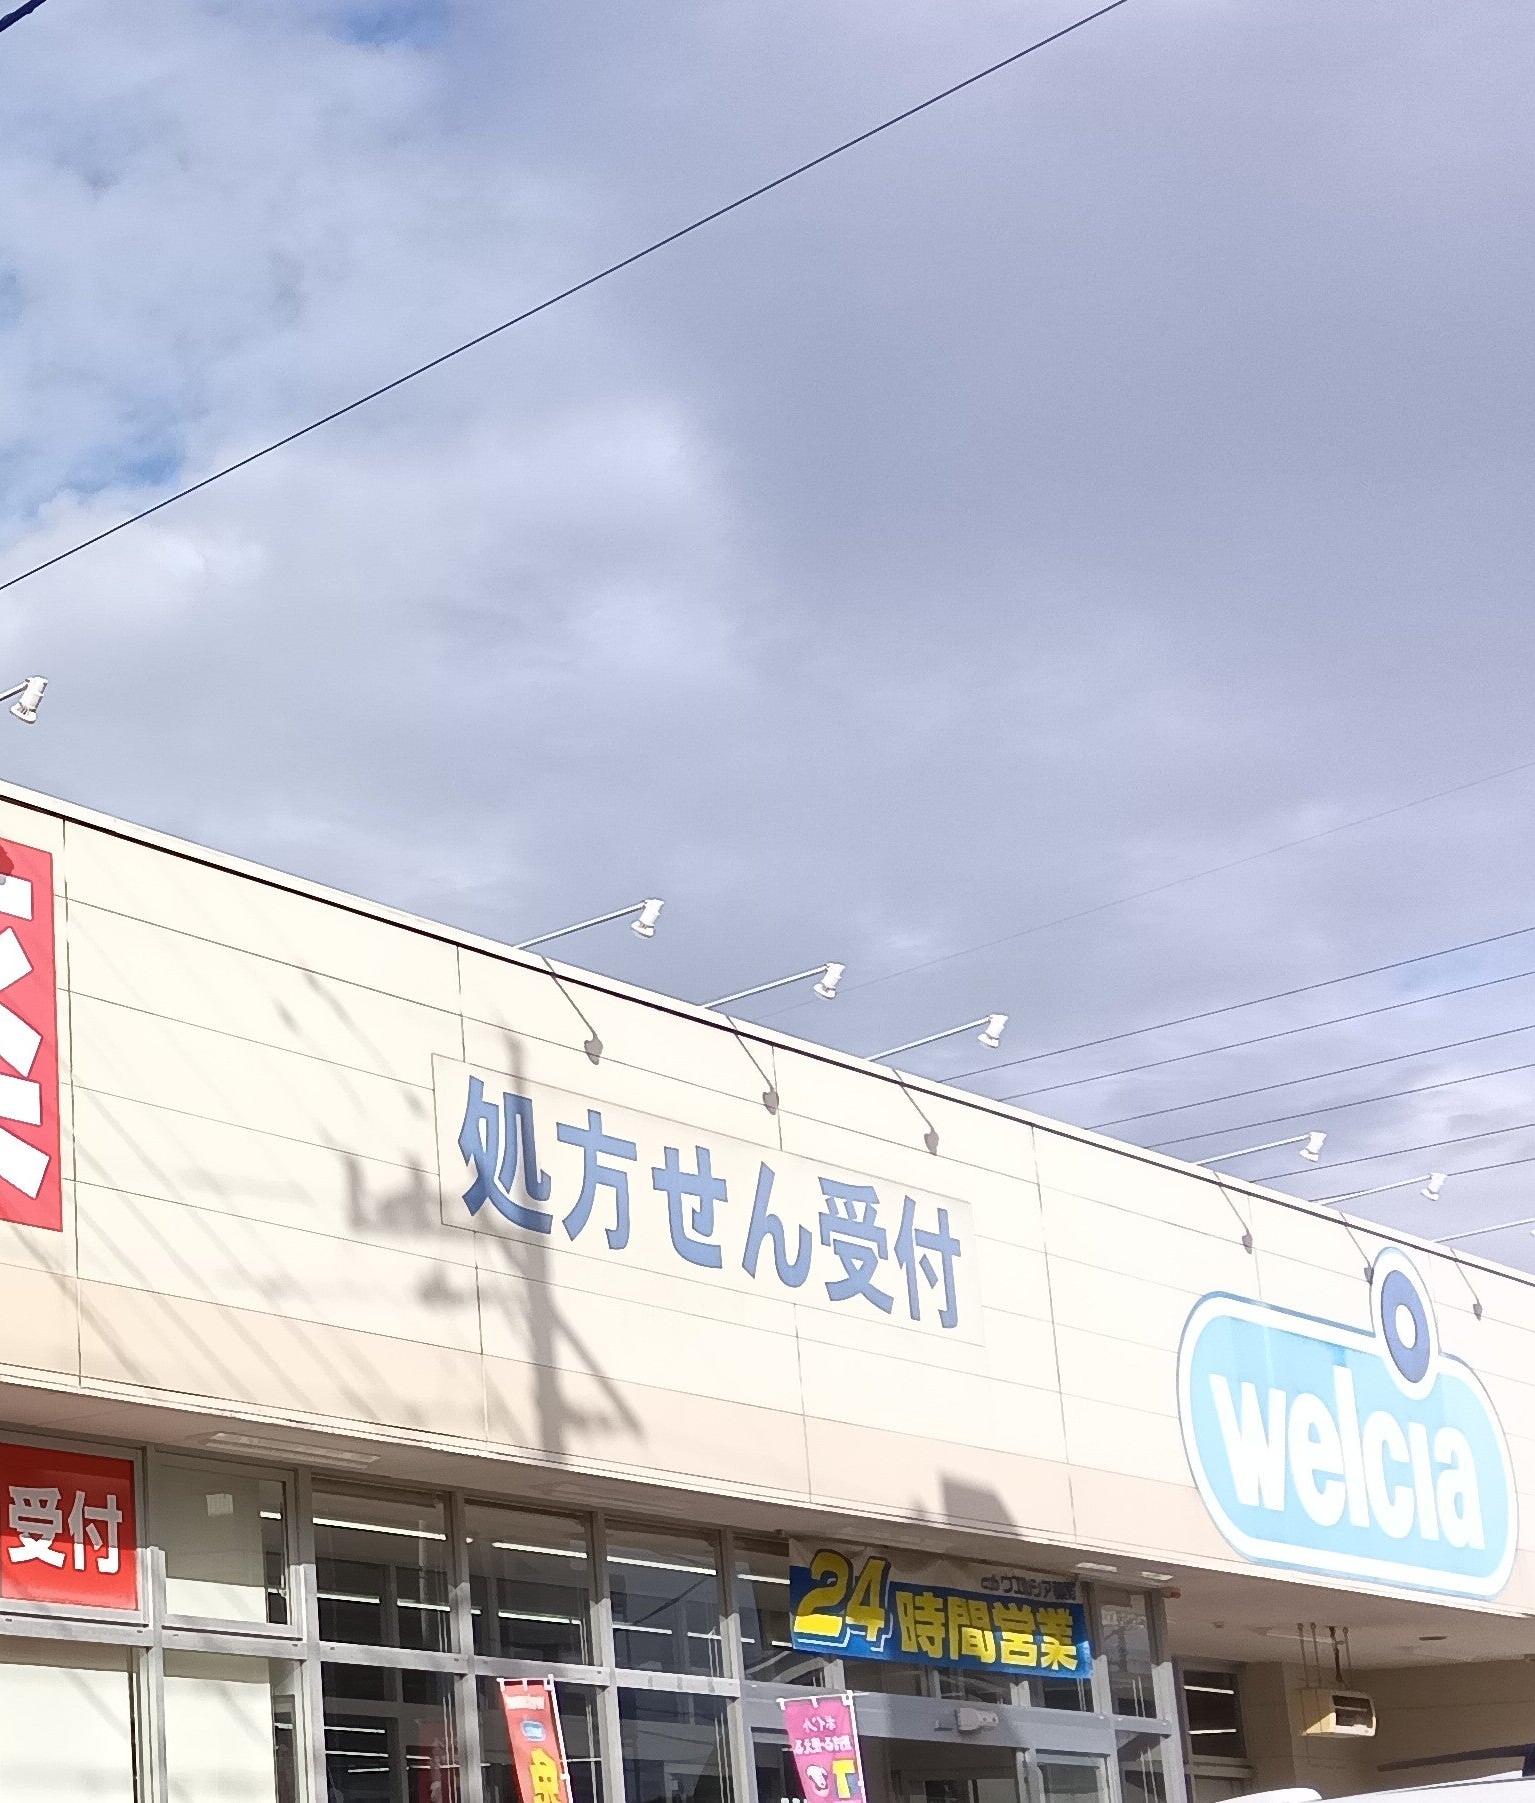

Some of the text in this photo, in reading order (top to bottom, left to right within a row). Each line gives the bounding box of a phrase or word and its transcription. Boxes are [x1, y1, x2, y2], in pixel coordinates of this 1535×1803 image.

[458, 1074, 962, 1329] 処方せん受付
[1208, 1269, 1486, 1550] welcia
[7, 1485, 123, 1574] 受付
[793, 1549, 1079, 1672] 24時間営業
